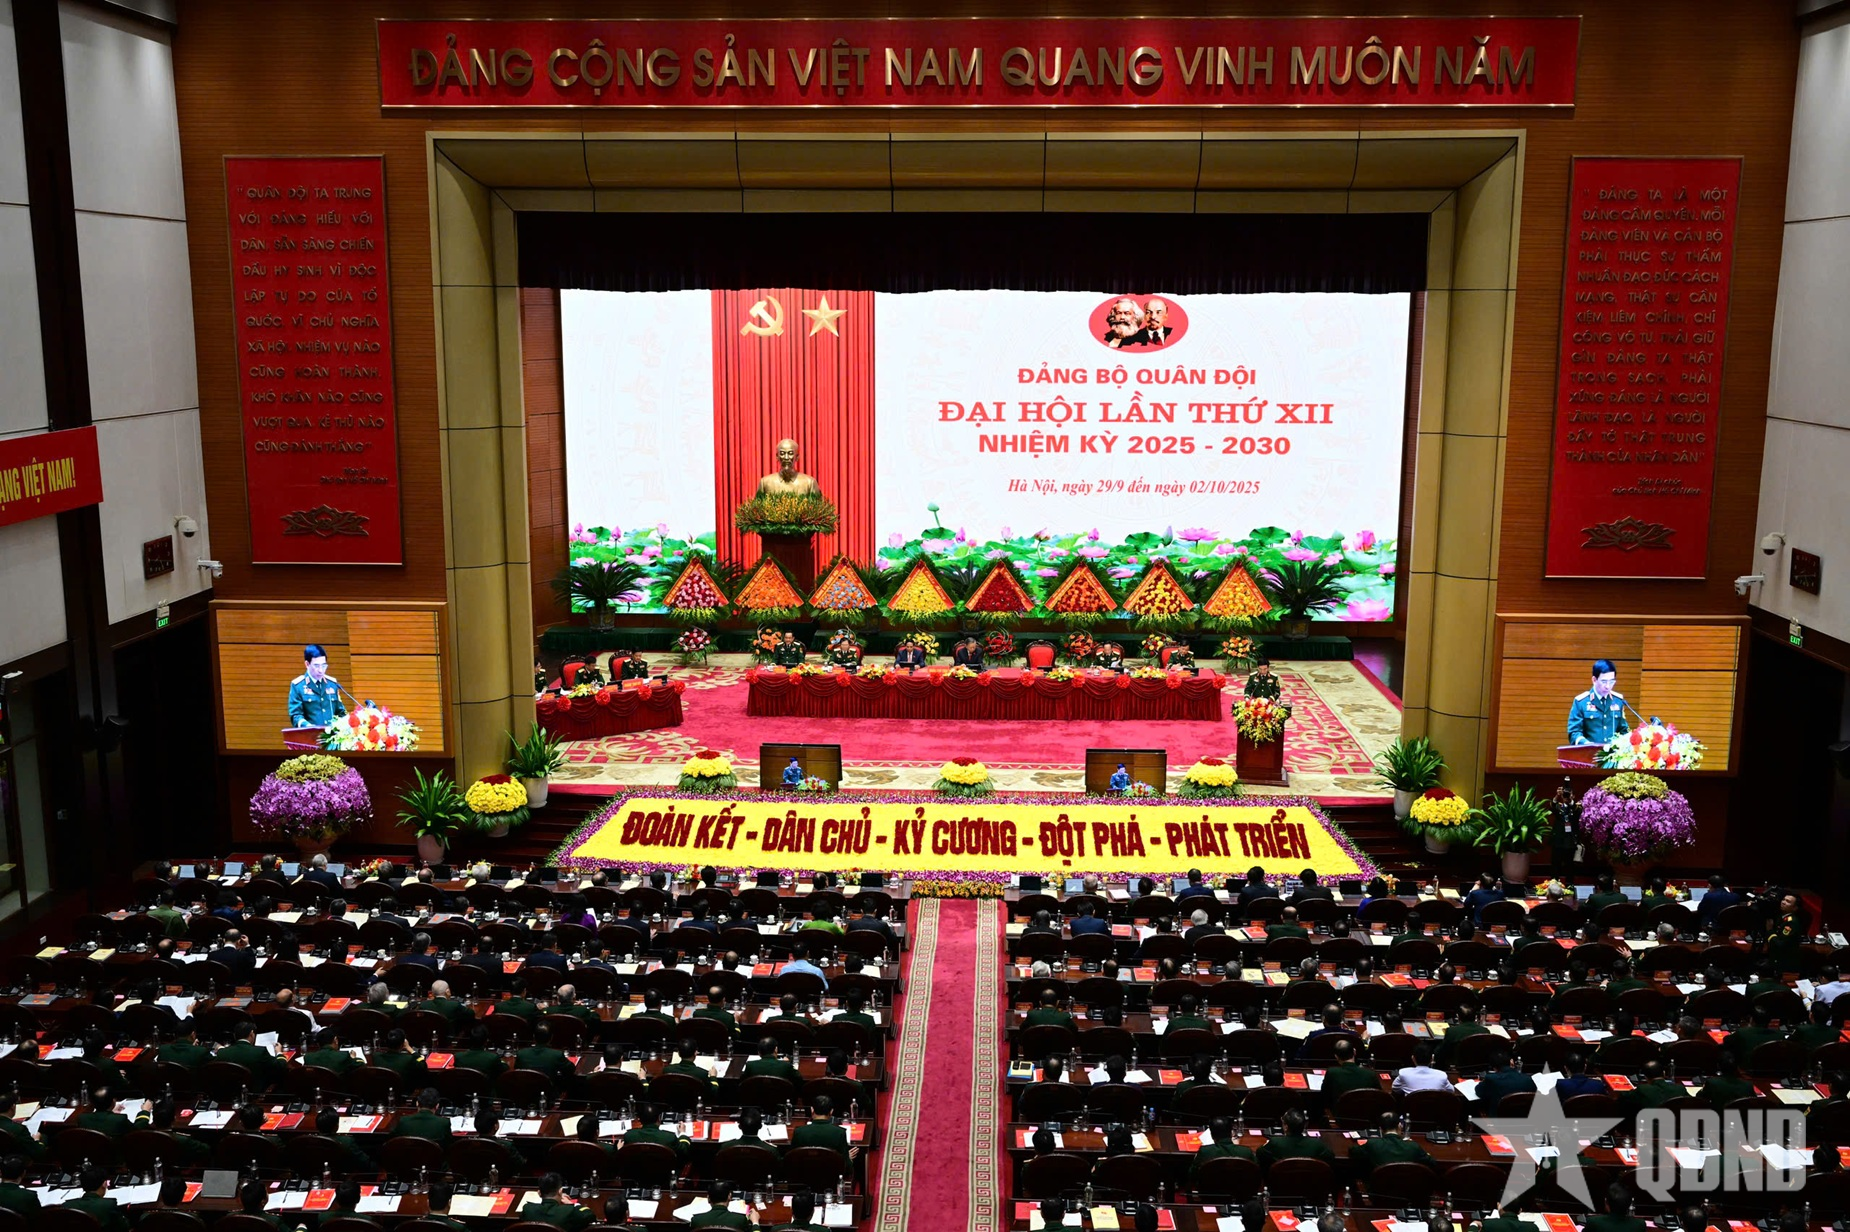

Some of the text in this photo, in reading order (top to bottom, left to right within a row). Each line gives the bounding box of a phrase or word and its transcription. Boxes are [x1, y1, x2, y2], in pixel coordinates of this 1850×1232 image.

[407, 33, 1534, 96] ĐẢNG CỘNG SẢN VIỆT NAM QUANG VINH MUÔN NĂM
[247, 185, 280, 199] QUÂN
[314, 187, 329, 199] TA
[333, 187, 372, 199] TRUNG
[1599, 185, 1638, 200] ĐẢNG
[1648, 190, 1663, 200] TA
[1700, 187, 1728, 202] MỘT
[238, 210, 261, 225] VỚI
[316, 210, 342, 225] HIẾU
[352, 210, 373, 225] VỚI
[1583, 206, 1619, 221] ĐẢNG
[1700, 206, 1725, 221] MỖI
[1580, 226, 1724, 244] ĐẢNG VIÊN VÀ CÁN BỘ
[302, 236, 335, 251] SÀNG
[339, 235, 375, 251] CHIẾN
[1579, 247, 1608, 262] PHẢI
[1618, 251, 1652, 264] THỰC
[242, 261, 377, 278] ĐẤU HY SINH VÌ ĐỘC
[1623, 272, 1650, 284] ĐẠO
[1681, 269, 1719, 283] CÁCH
[244, 288, 266, 303] LẬP
[297, 291, 317, 301] DO
[326, 288, 353, 301] CỦA
[1628, 290, 1657, 304] THẬT
[309, 312, 334, 327] CHỦ
[341, 314, 380, 327] NGHĨA
[1610, 310, 1636, 323] LIÊM
[1693, 309, 1716, 323] CHÍ
[1572, 330, 1612, 344] CÔNG
[1617, 330, 1636, 343] VÔ
[1692, 330, 1716, 344] GIỮ
[247, 339, 265, 352] XÃ
[296, 339, 331, 355] NHIỆM
[334, 341, 349, 355] VỤ
[353, 339, 381, 352] NÀO
[1606, 348, 1646, 364] ĐẢNG
[249, 364, 286, 377] CŨNG
[1018, 362, 1256, 390] ĐẢNG BỘ QUÂN ĐỘI
[1570, 371, 1618, 383] TRONG
[1681, 369, 1712, 384] PHẢI
[251, 389, 276, 402] KHÓ
[318, 389, 344, 402] NÀO
[348, 390, 384, 402] CŨNG
[939, 390, 1334, 428] ĐẠI HỘI LẦN THỨ XII
[252, 416, 283, 430] VƯỢT
[358, 414, 385, 428] NÀO
[255, 439, 289, 452] CŨNG
[979, 430, 1069, 458] NHIỆM
[1080, 430, 1118, 453] KỲ
[1128, 436, 1195, 454] 2025
[1222, 436, 1291, 455] 2030
[1661, 432, 1706, 444] TRUNG
[22, 457, 45, 503] VIỆT
[46, 457, 76, 492] NAM!
[1008, 479, 1260, 496] Hà Nội, ngày 29/9 đến ngày 02/10/2025
[158, 618, 168, 628] EXIT
[1790, 634, 1800, 646] EXIT
[620, 804, 696, 848] ĐOÀN
[693, 803, 745, 850] KẾT
[746, 832, 757, 840] -
[762, 810, 816, 852] DÂN
[820, 807, 871, 854] CHỦ
[893, 807, 926, 854] KỶ
[932, 817, 1016, 856] CƯƠNG
[1022, 837, 1033, 845] -
[1039, 814, 1086, 866] ĐỘT
[1092, 815, 1145, 857] PHÁ
[1165, 815, 1230, 857] PHÁT
[1234, 809, 1312, 860] TRIỂN
